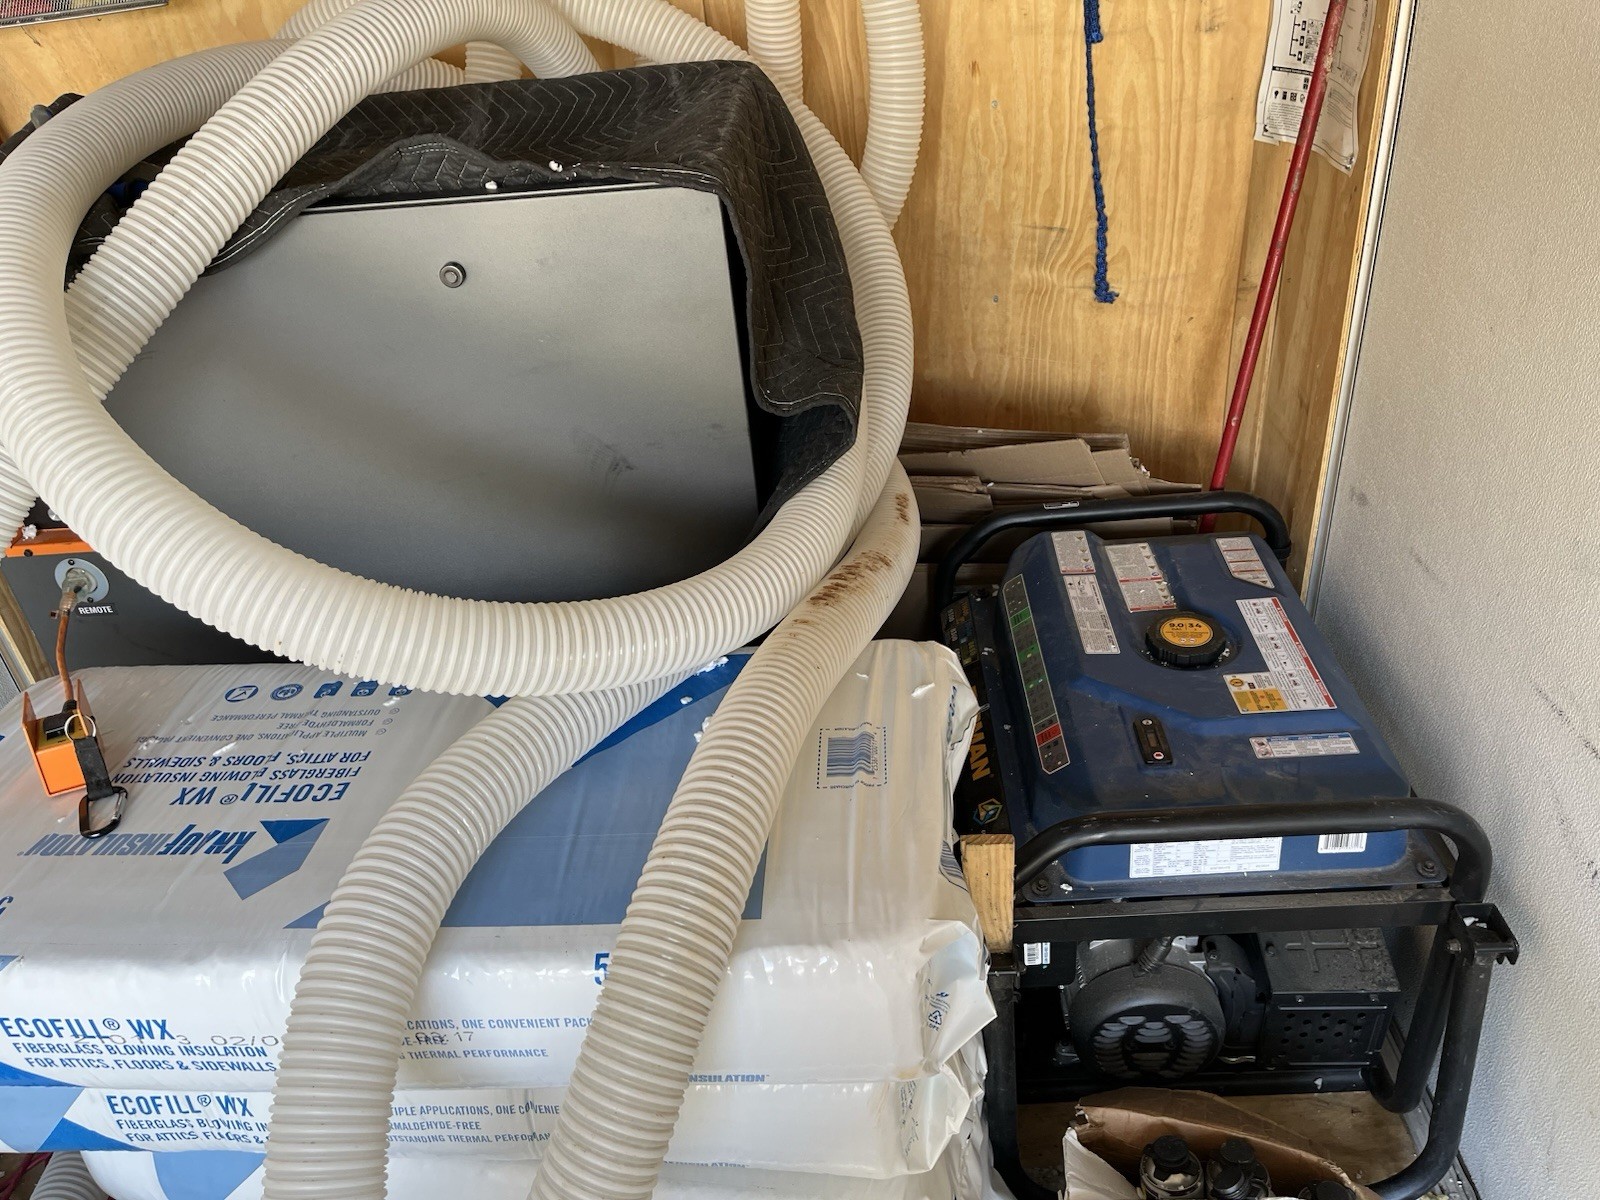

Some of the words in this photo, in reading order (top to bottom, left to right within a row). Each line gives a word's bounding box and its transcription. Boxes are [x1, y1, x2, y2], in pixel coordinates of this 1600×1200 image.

[78, 605, 114, 615] REMOTE
[211, 712, 278, 722] PERFORMANCE
[281, 709, 319, 720] THRMAL
[321, 709, 381, 718] OUTSTANDING
[174, 734, 234, 743] CONVENIENT
[235, 733, 255, 741] ONE
[324, 730, 368, 738] MULTIPLE
[208, 756, 222, 767] &
[286, 752, 339, 765] ATTICS,
[339, 751, 372, 762] FOR
[123, 756, 206, 769] SIDEWALLS
[112, 770, 198, 784] INSULATION
[269, 767, 362, 781] FIBERGLASS
[169, 786, 218, 806] WX
[126, 1019, 176, 1040] WX
[404, 1018, 459, 1031] CATIONS,
[462, 1018, 485, 1030] ONE
[488, 1017, 561, 1029] CONVENIENT
[12, 1042, 104, 1055] FIBERGLASS
[104, 1044, 176, 1056] BLOWING
[177, 1045, 268, 1058] INSULATION
[408, 1050, 461, 1060] THERMAL
[464, 1049, 549, 1059] PERFORMANCE
[24, 1057, 59, 1068] FOR
[60, 1058, 116, 1070] ATTICS,
[113, 1059, 175, 1070] FLOORS
[176, 1060, 190, 1071] &
[191, 1061, 278, 1073] SIDEWALLS
[215, 1095, 254, 1118] WX
[420, 1105, 493, 1116] APPLICATIONS,
[495, 1105, 516, 1115] ONE
[116, 1119, 194, 1131] FIBERGLASS
[125, 1133, 153, 1143] FOR
[253, 1135, 264, 1145] &
[447, 1134, 493, 1144] THERMAL
